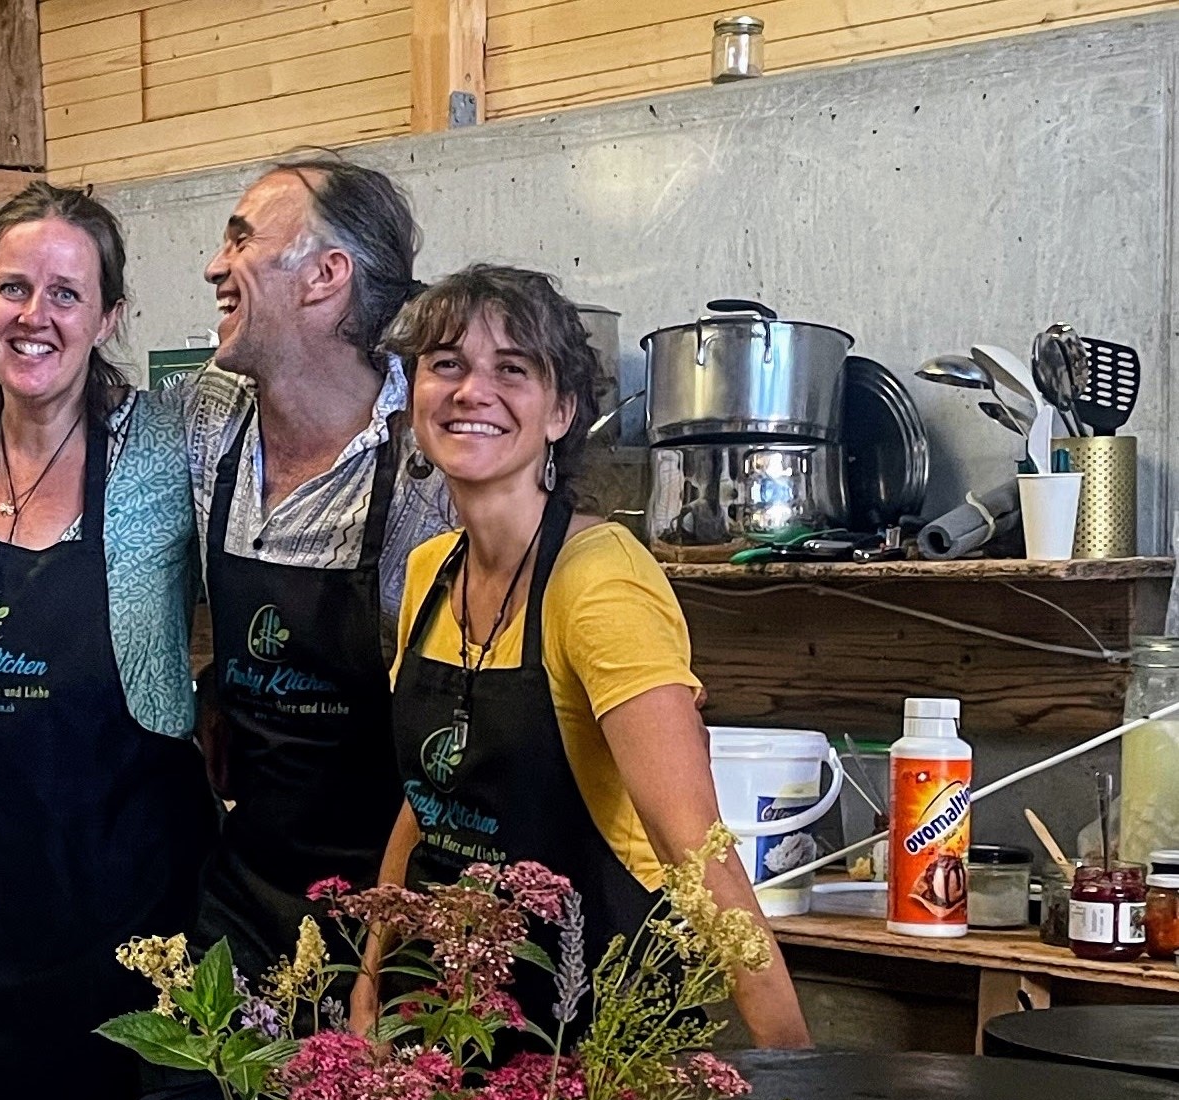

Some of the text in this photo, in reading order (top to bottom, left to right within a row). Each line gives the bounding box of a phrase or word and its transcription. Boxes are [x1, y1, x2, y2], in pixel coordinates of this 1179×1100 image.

[4, 686, 21, 699] und
[24, 686, 50, 699] Liebe
[300, 702, 318, 714] und
[321, 702, 349, 715] Liebe
[441, 799, 499, 835] Kitchen
[442, 834, 461, 854] Herz
[477, 845, 507, 862] Liebe
